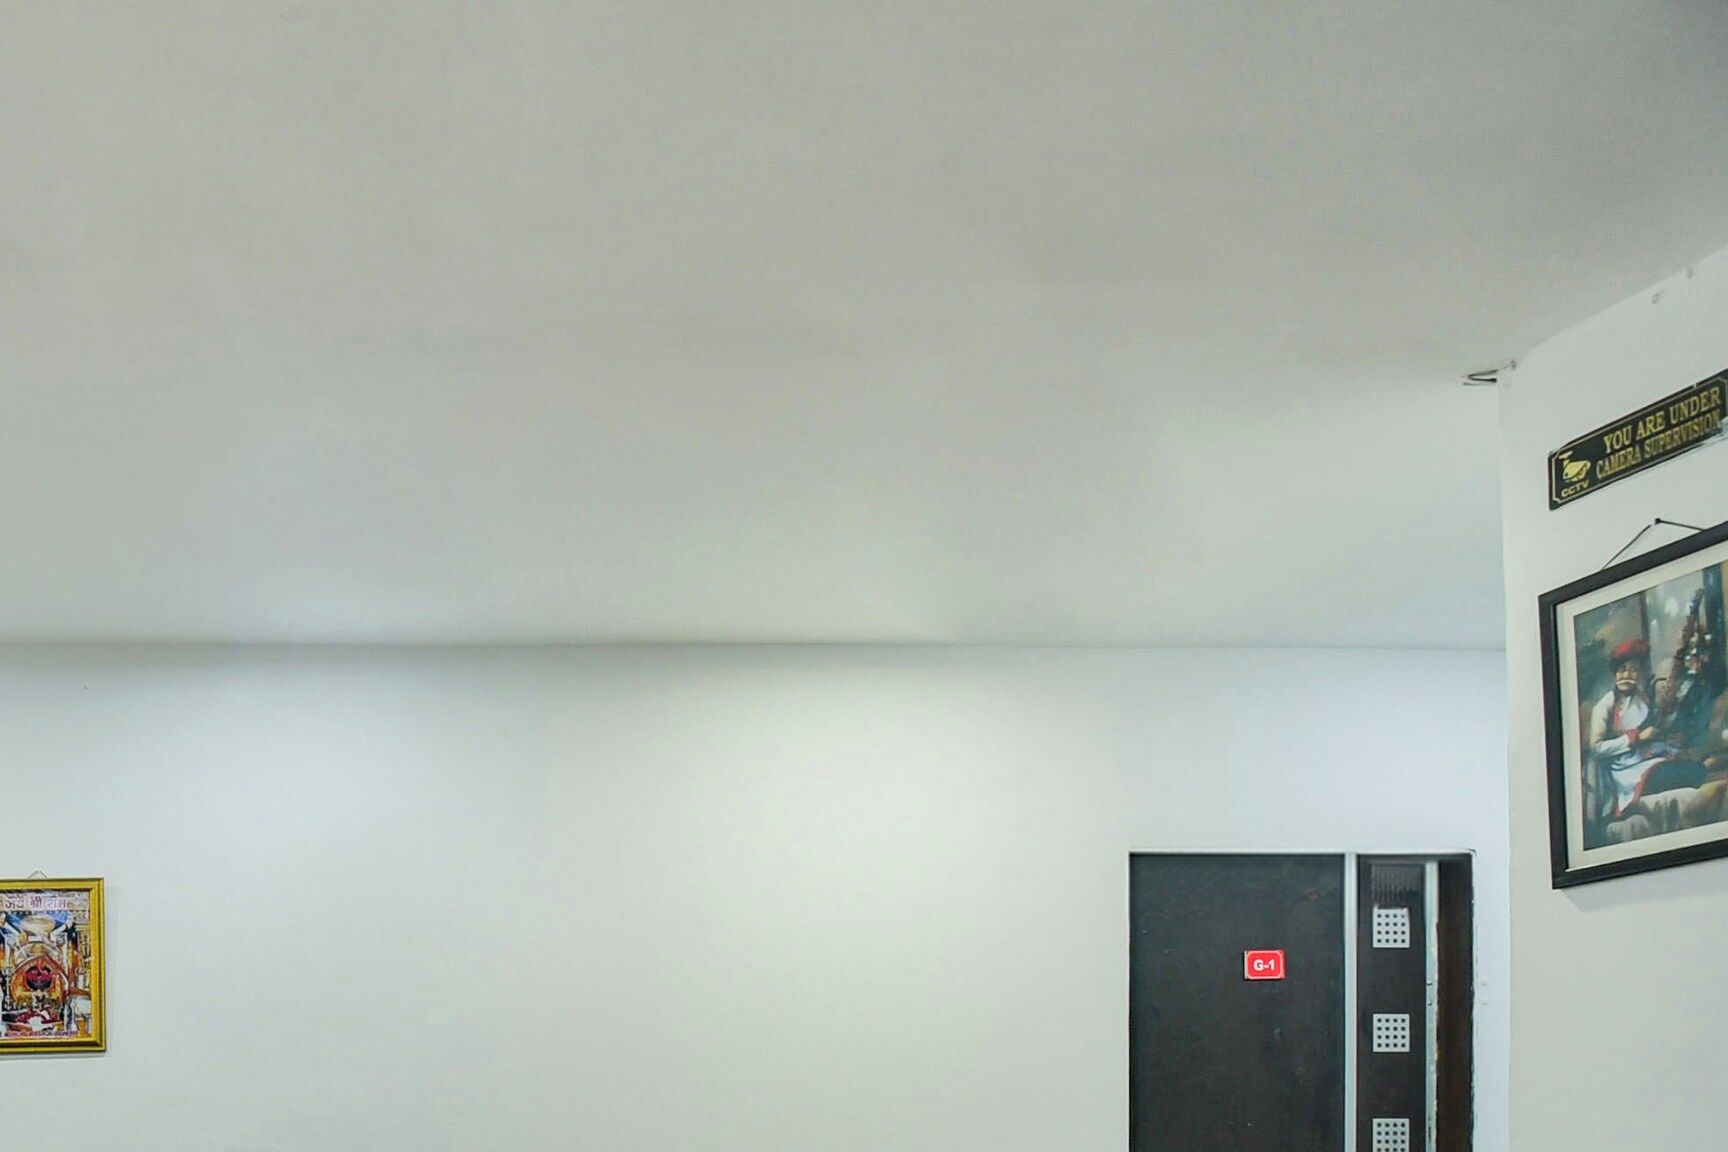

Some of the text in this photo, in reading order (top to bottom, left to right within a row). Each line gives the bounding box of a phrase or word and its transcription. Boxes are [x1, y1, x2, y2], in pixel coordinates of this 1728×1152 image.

[1603, 387, 1721, 453] YOU ARE UNDER
[1596, 409, 1721, 479] CAMERA SUPERVISION
[1561, 480, 1589, 497] CCTV
[1253, 959, 1275, 972] G-1
